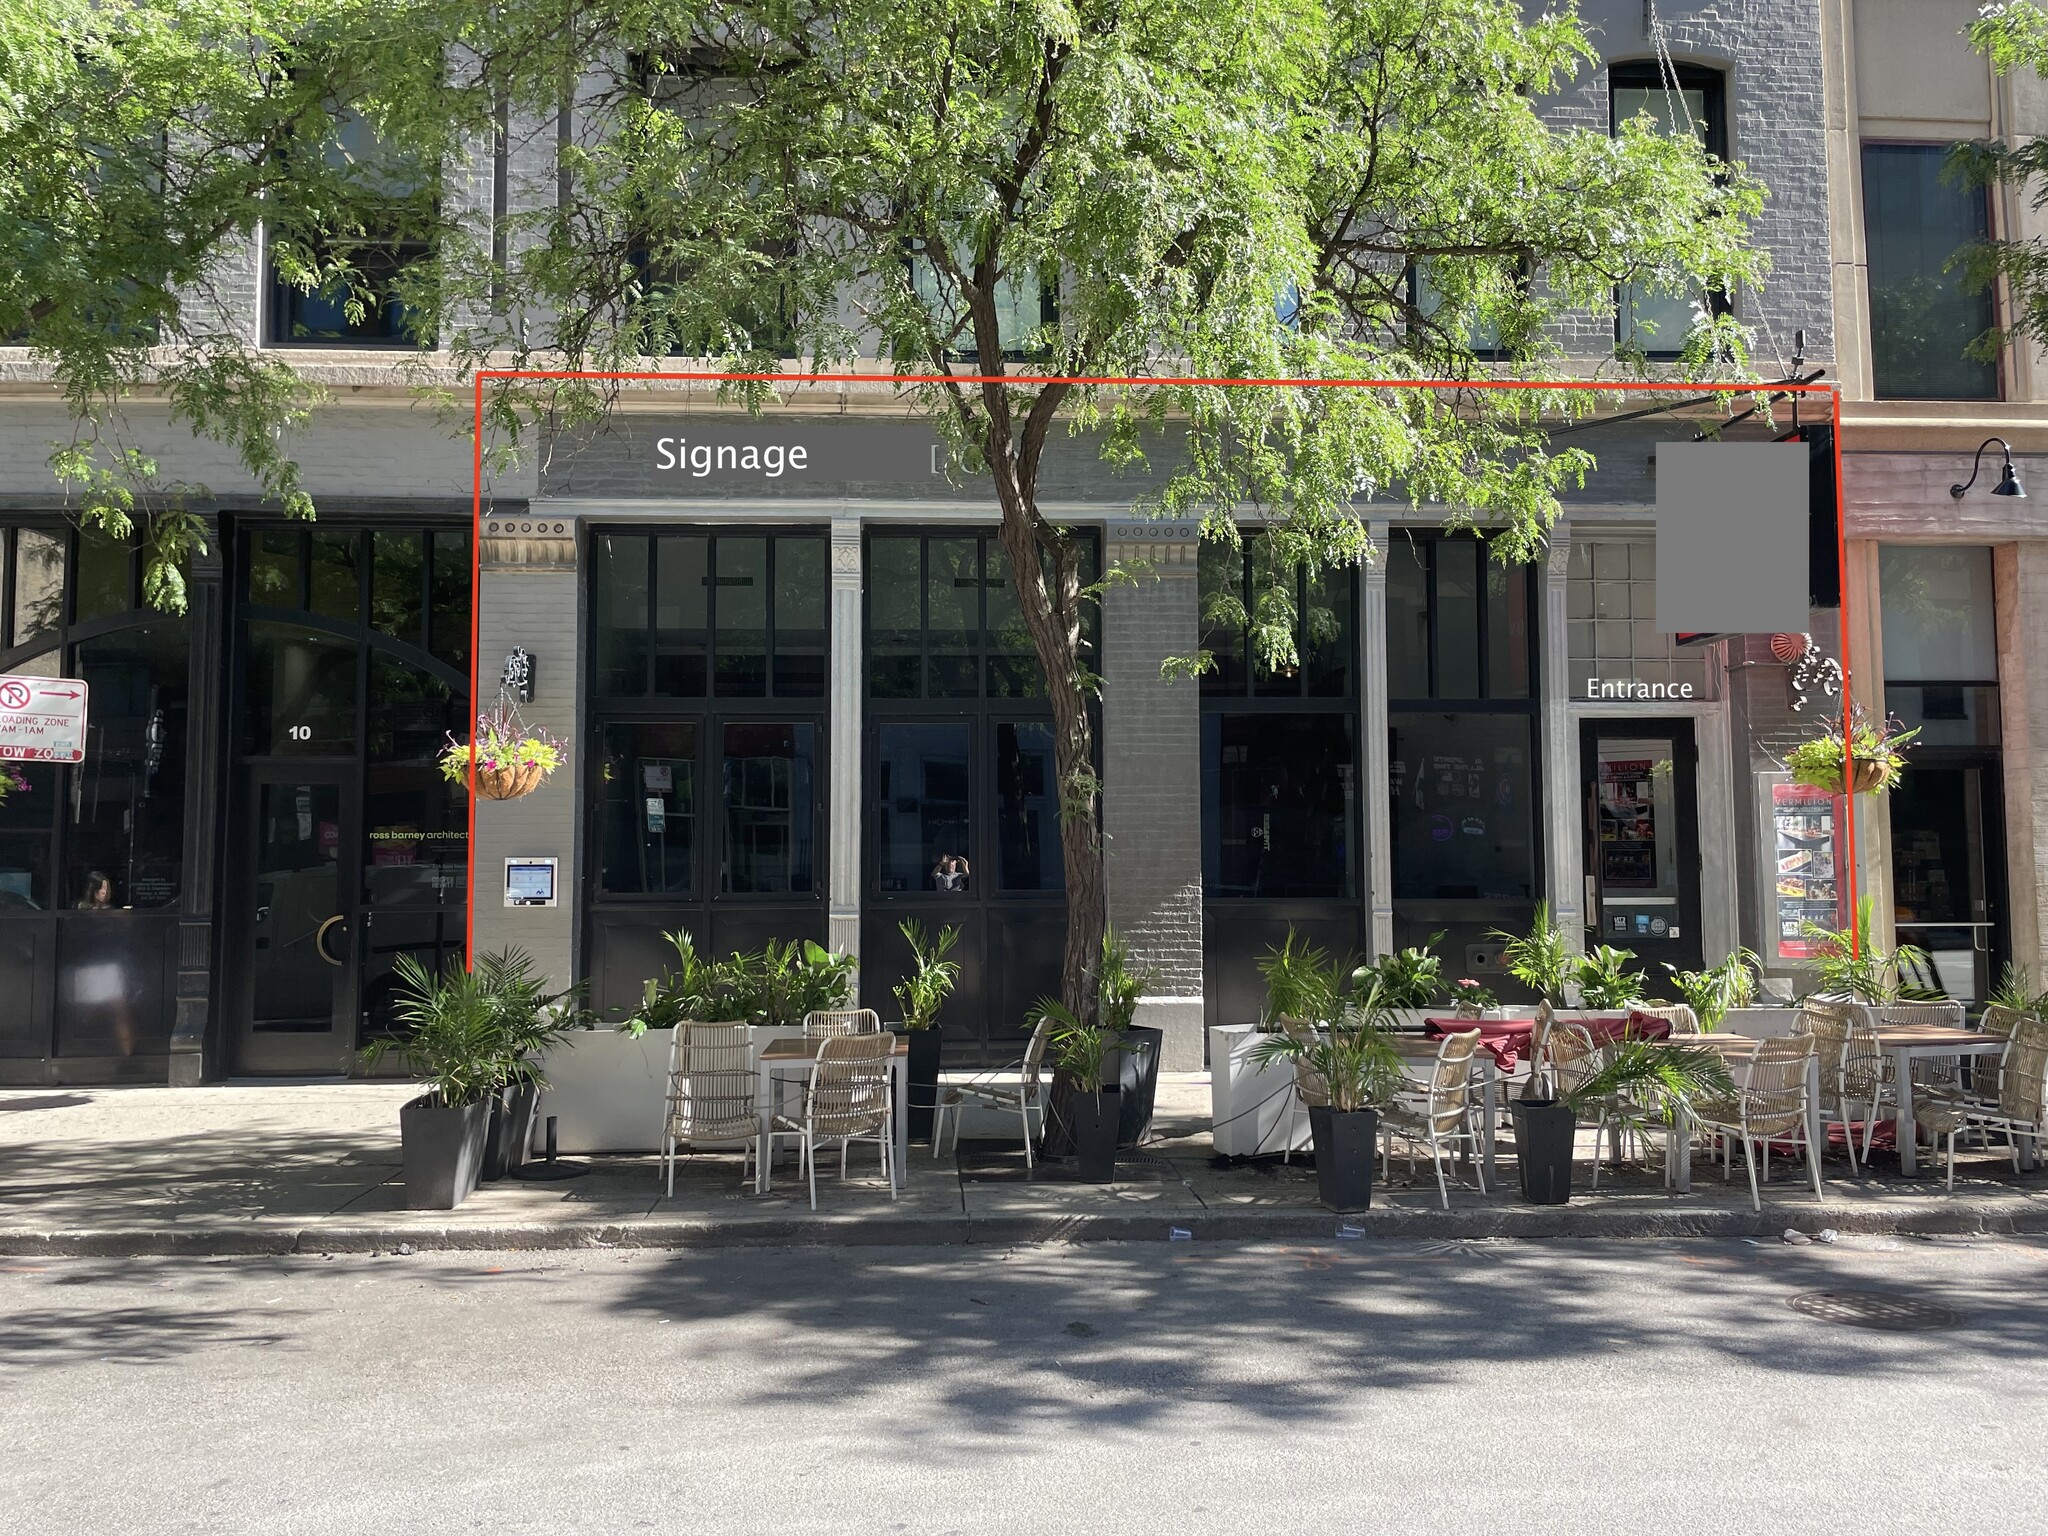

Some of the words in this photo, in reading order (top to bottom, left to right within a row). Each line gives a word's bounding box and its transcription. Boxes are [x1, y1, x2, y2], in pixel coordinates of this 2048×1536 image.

[0, 715, 38, 725] OADING
[44, 718, 69, 727] ZONE
[289, 725, 311, 740] 10
[34, 748, 73, 760] ZO
[1775, 798, 1832, 806] VERMILION
[369, 831, 390, 839] ross
[391, 831, 425, 840] barney
